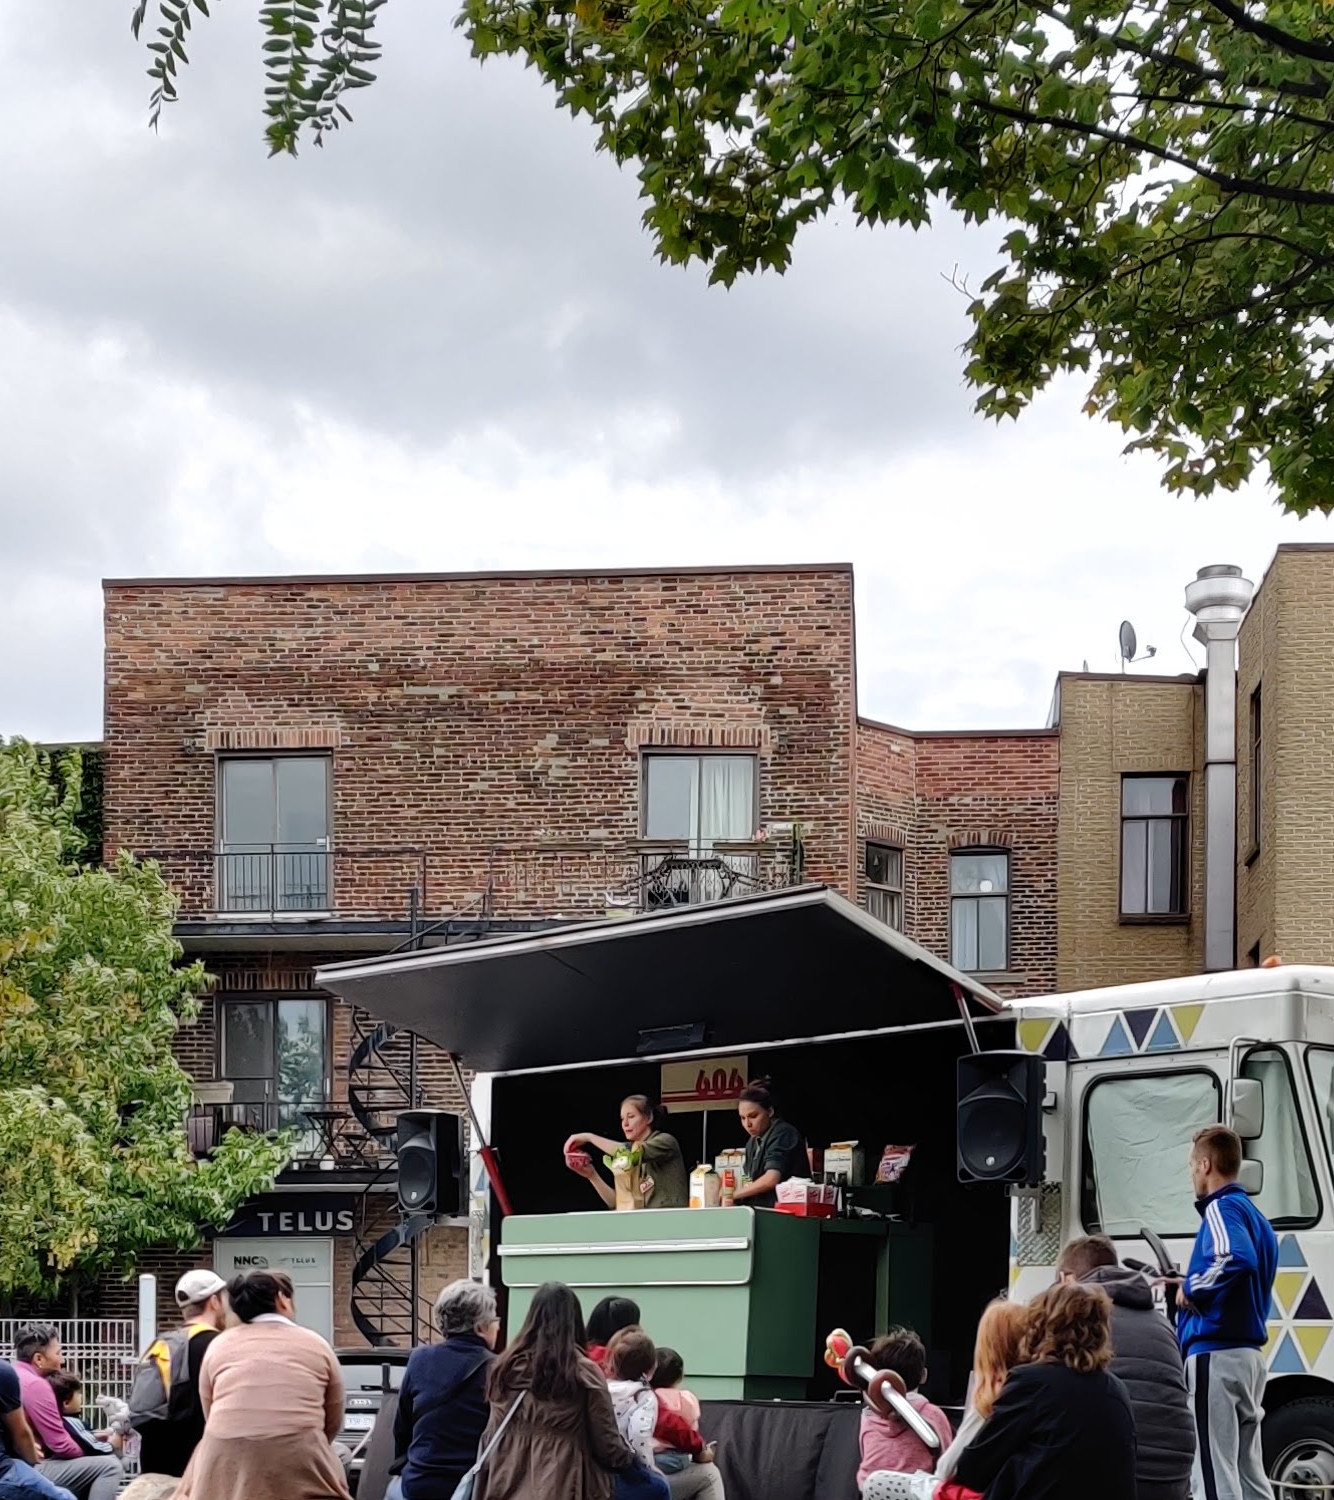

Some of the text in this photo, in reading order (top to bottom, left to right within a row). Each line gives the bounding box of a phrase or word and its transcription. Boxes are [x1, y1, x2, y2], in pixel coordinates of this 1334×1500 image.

[695, 1068, 744, 1096] 606
[256, 1210, 354, 1232] TELUS
[233, 1255, 260, 1266] NNC
